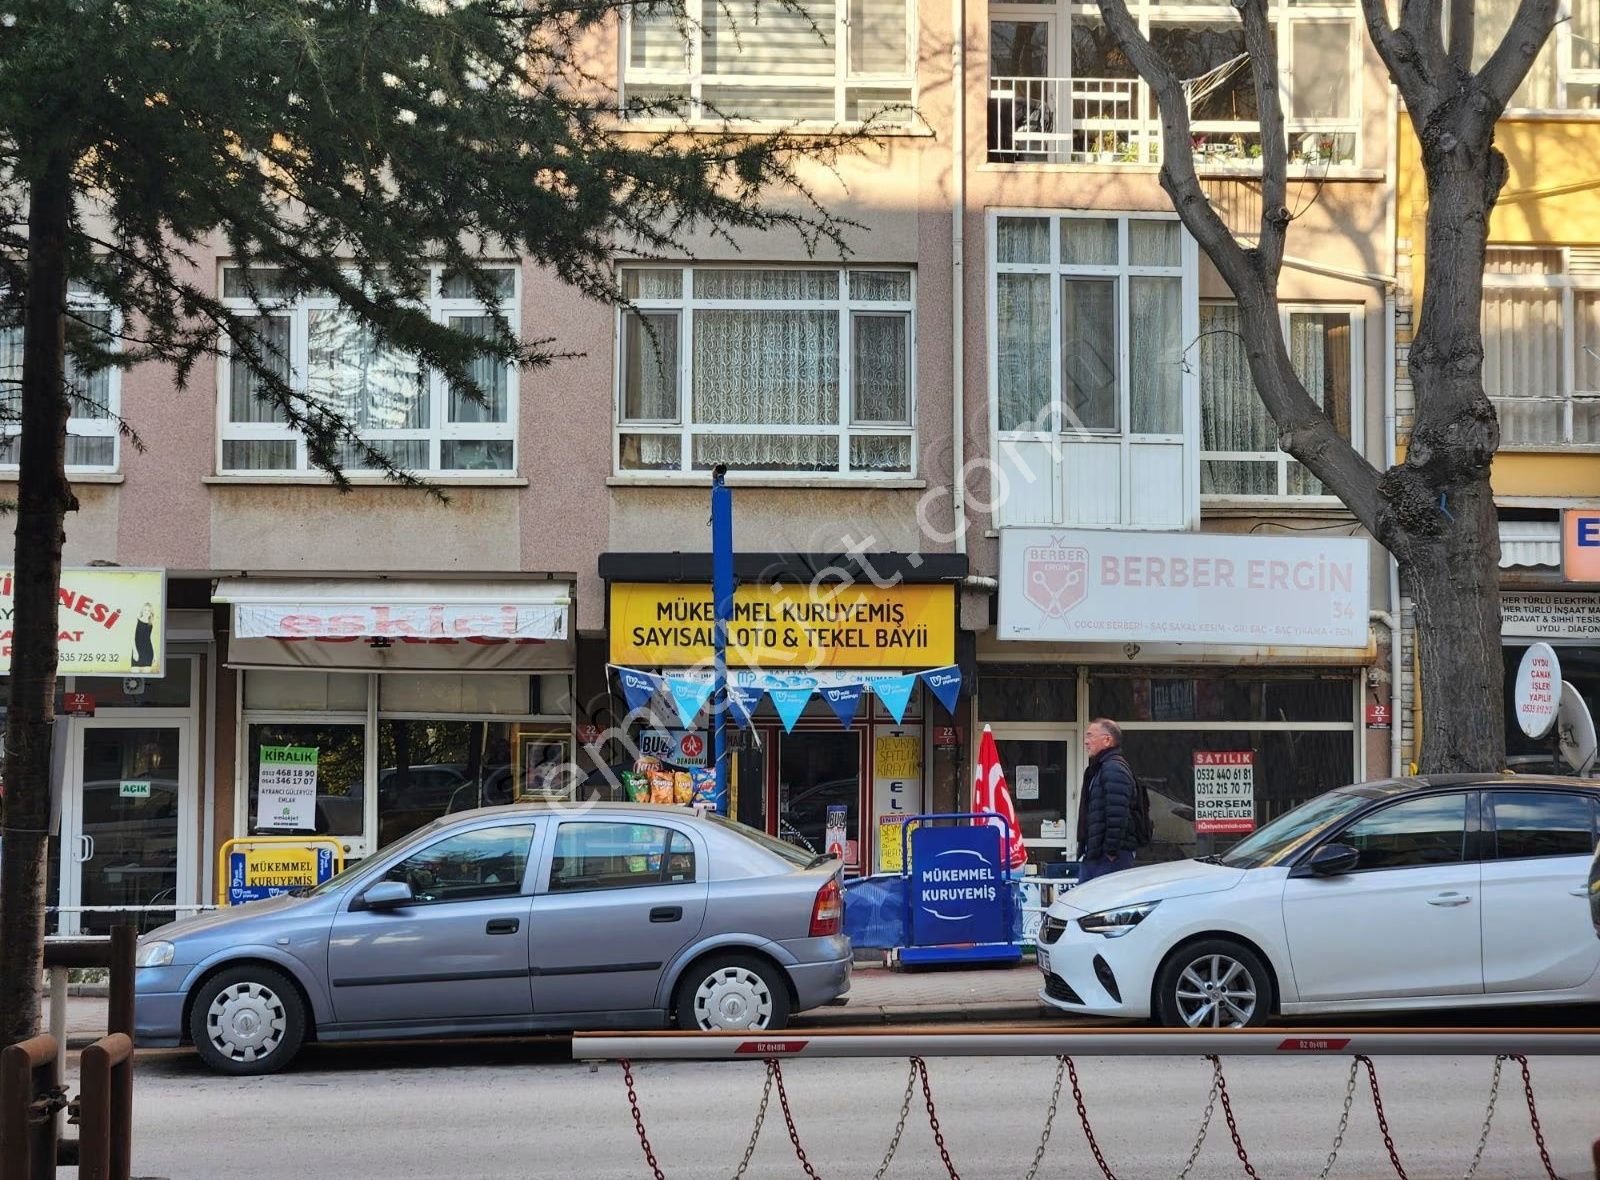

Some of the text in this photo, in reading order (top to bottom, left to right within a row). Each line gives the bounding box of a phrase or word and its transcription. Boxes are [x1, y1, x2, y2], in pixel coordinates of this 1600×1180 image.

[1030, 550, 1085, 561] BERBER
[1101, 553, 1353, 592] BERBER ERGİN
[1502, 596, 1521, 604] HER
[656, 597, 904, 628] MÜKEMEL KURUYEMİŞ
[632, 624, 928, 648] SAYISAL LOTO & TEKEL BAYİİ
[78, 653, 93, 662] 725
[95, 653, 106, 662] 92
[108, 653, 120, 662] 32
[75, 694, 85, 702] 22
[1375, 706, 1384, 715] 22
[943, 727, 953, 736] 22
[264, 748, 313, 762] KİRALIK
[1196, 753, 1251, 764] SATILIK
[276, 769, 292, 777] 468
[293, 769, 303, 777] 18
[1196, 768, 1251, 780] 0532 440 61 81
[122, 784, 147, 793] AÇIK
[1196, 783, 1251, 795] 0312 215 70 77
[250, 861, 313, 873] MÜKEMMEL
[922, 867, 995, 883] MÜKEMMEL
[922, 884, 996, 901] KURUYEMİŞ
